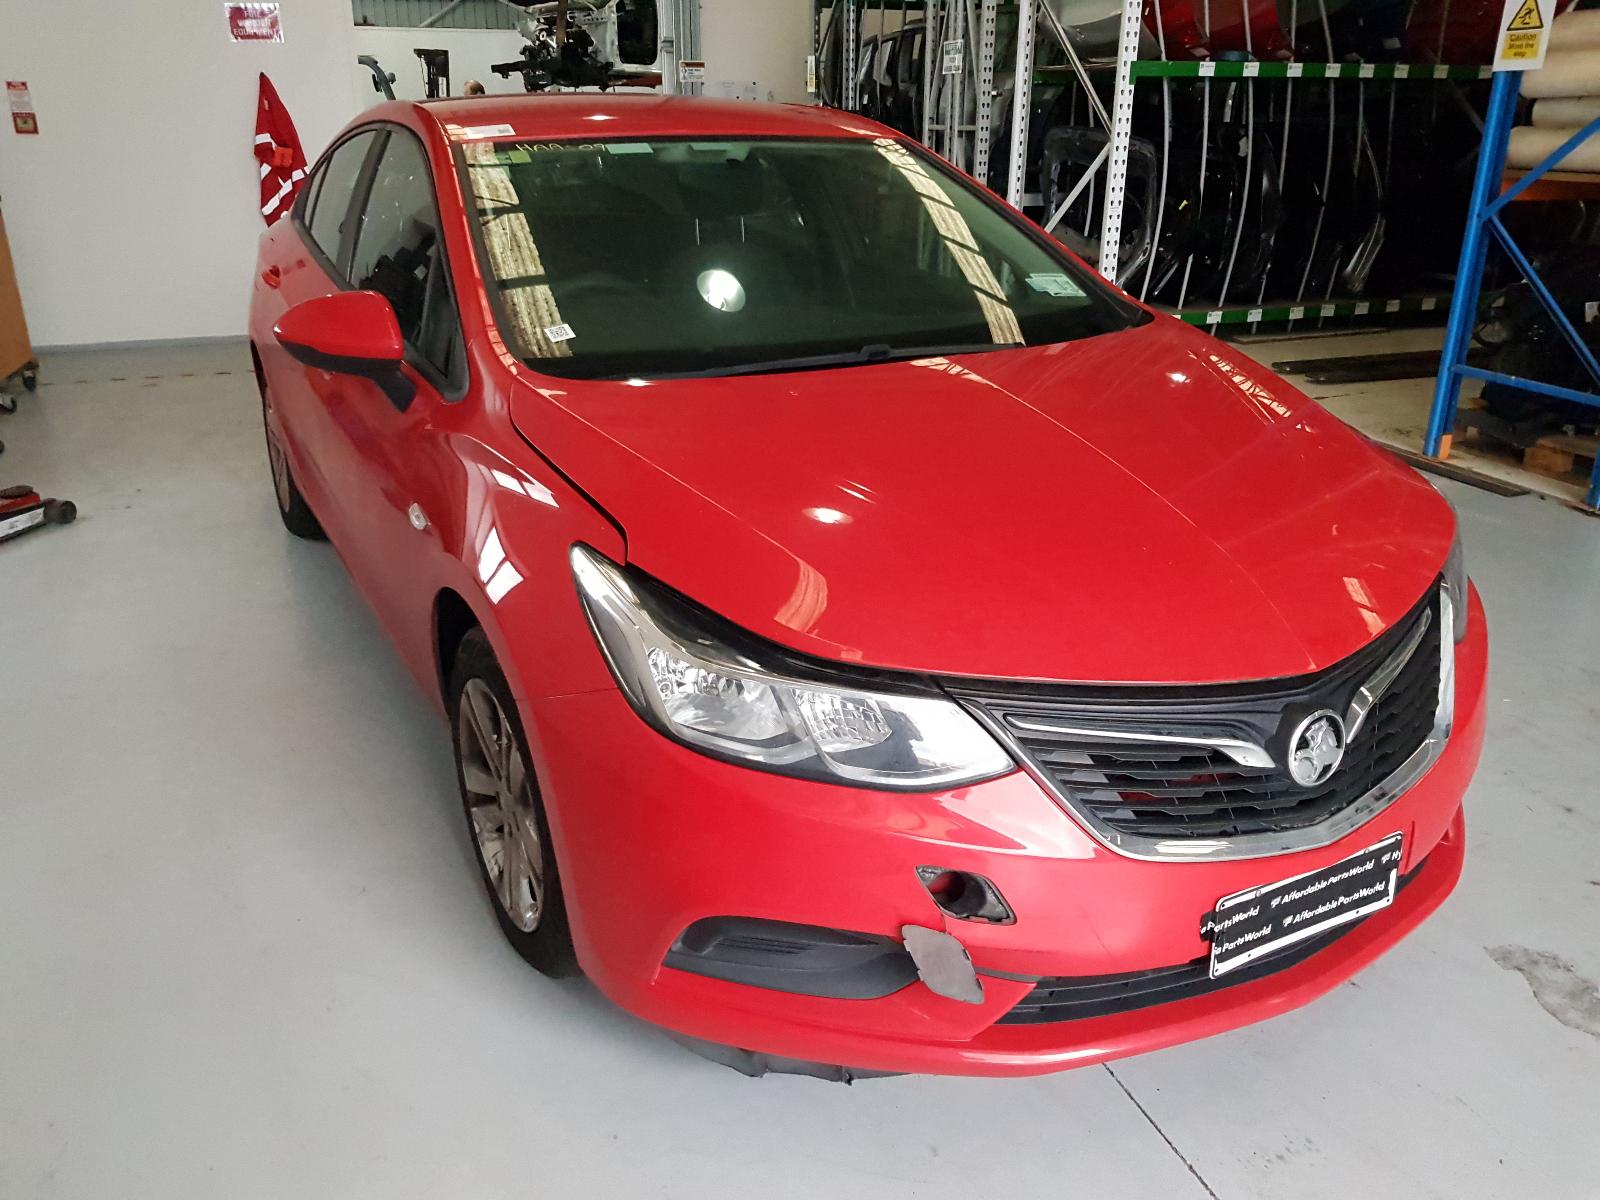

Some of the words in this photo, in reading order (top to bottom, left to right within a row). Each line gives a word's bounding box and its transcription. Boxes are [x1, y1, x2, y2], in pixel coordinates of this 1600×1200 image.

[1510, 33, 1537, 41] Caution
[1281, 880, 1328, 904] Affordable
[1327, 859, 1374, 885] PartsWorld
[1293, 899, 1337, 924] Affordable
[1337, 881, 1385, 905] PartsWorld
[1222, 924, 1272, 952] PartsWorld
